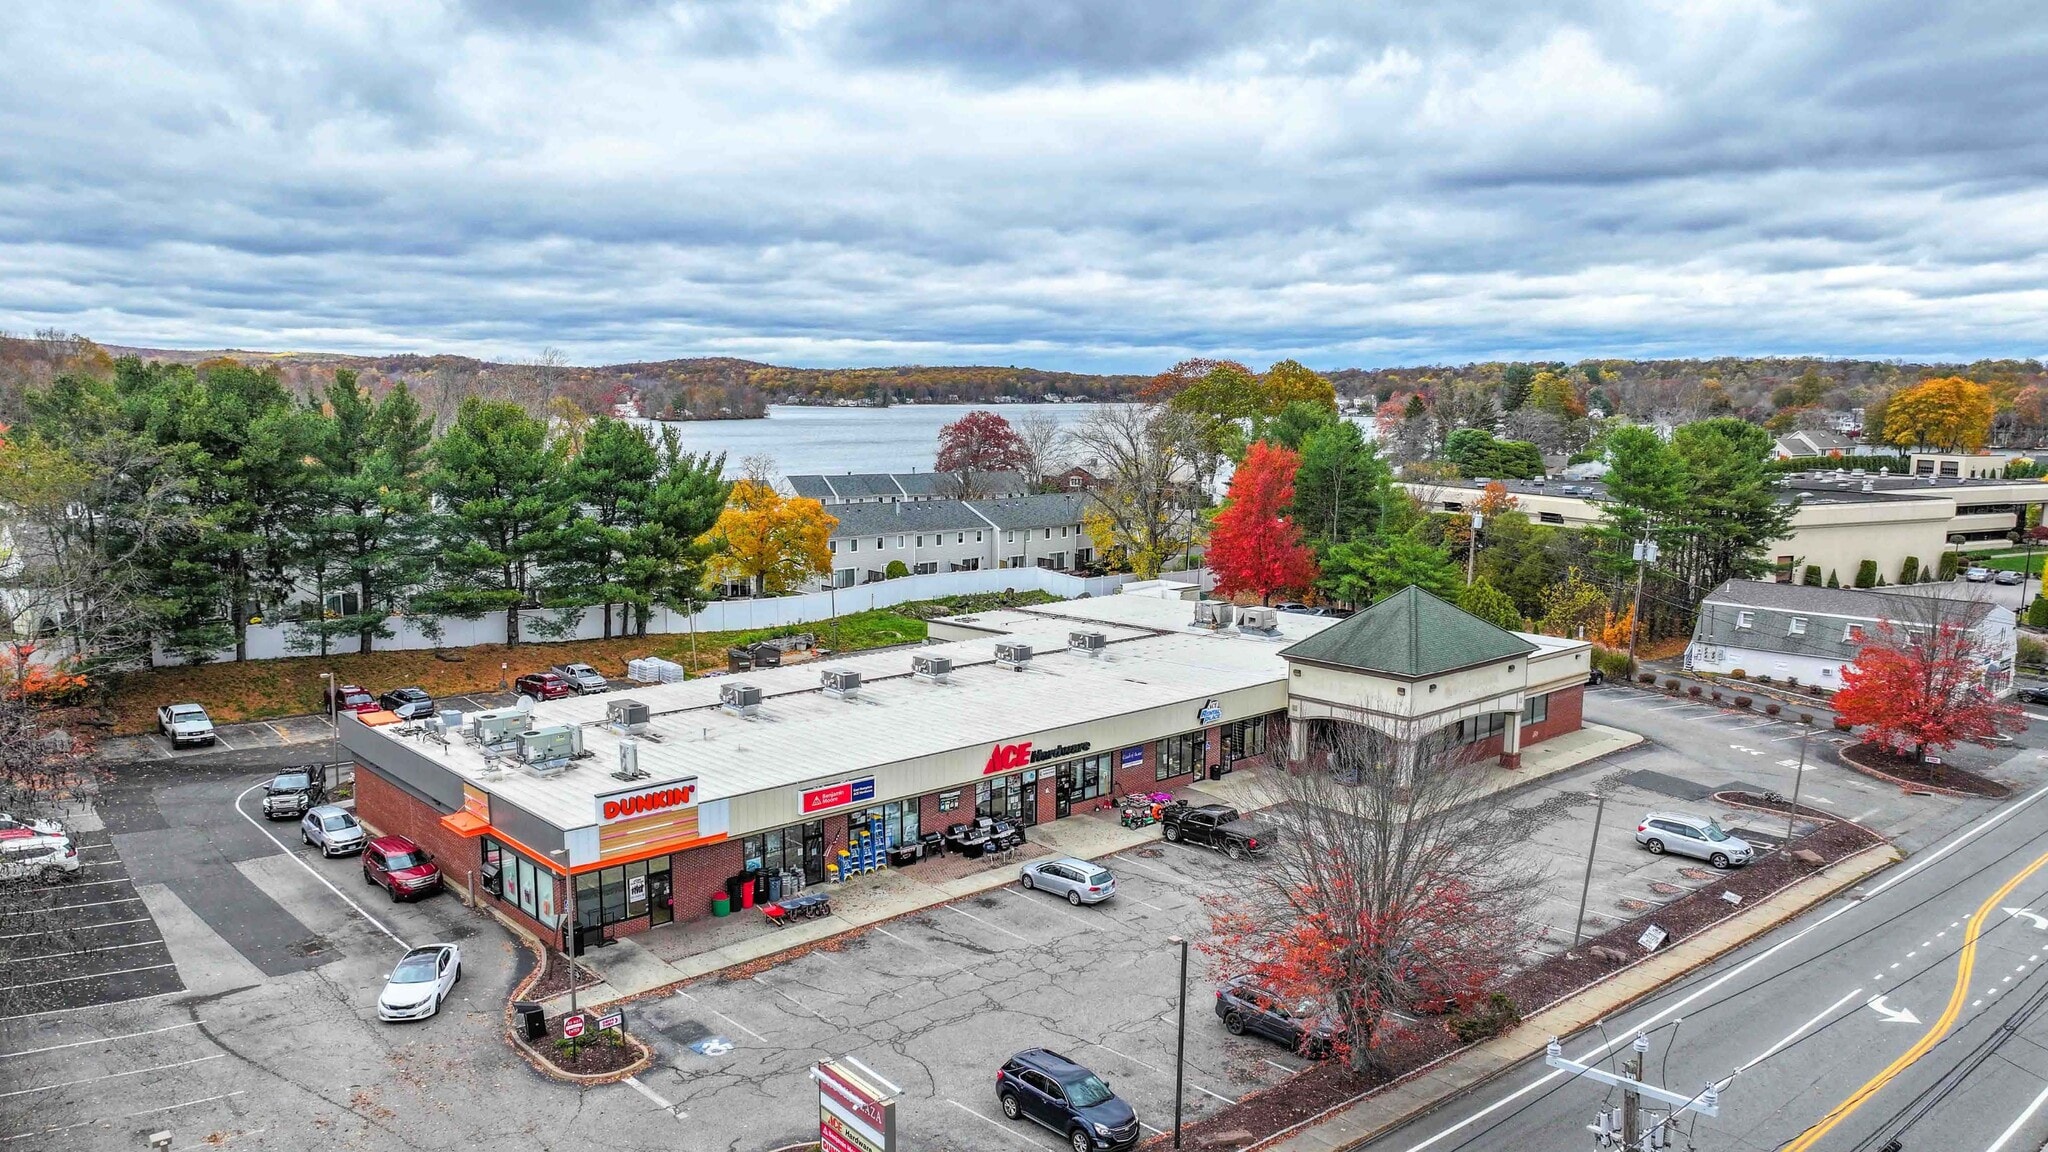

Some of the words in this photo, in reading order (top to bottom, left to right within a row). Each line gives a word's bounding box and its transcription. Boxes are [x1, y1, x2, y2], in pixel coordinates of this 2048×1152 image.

[983, 742, 1032, 774] ACE
[1030, 742, 1091, 763] Hardware
[603, 785, 695, 819] DUNKIN'
[822, 790, 844, 799] Benjamin
[828, 1115, 842, 1132] ACE
[845, 1129, 873, 1152] Hardware
